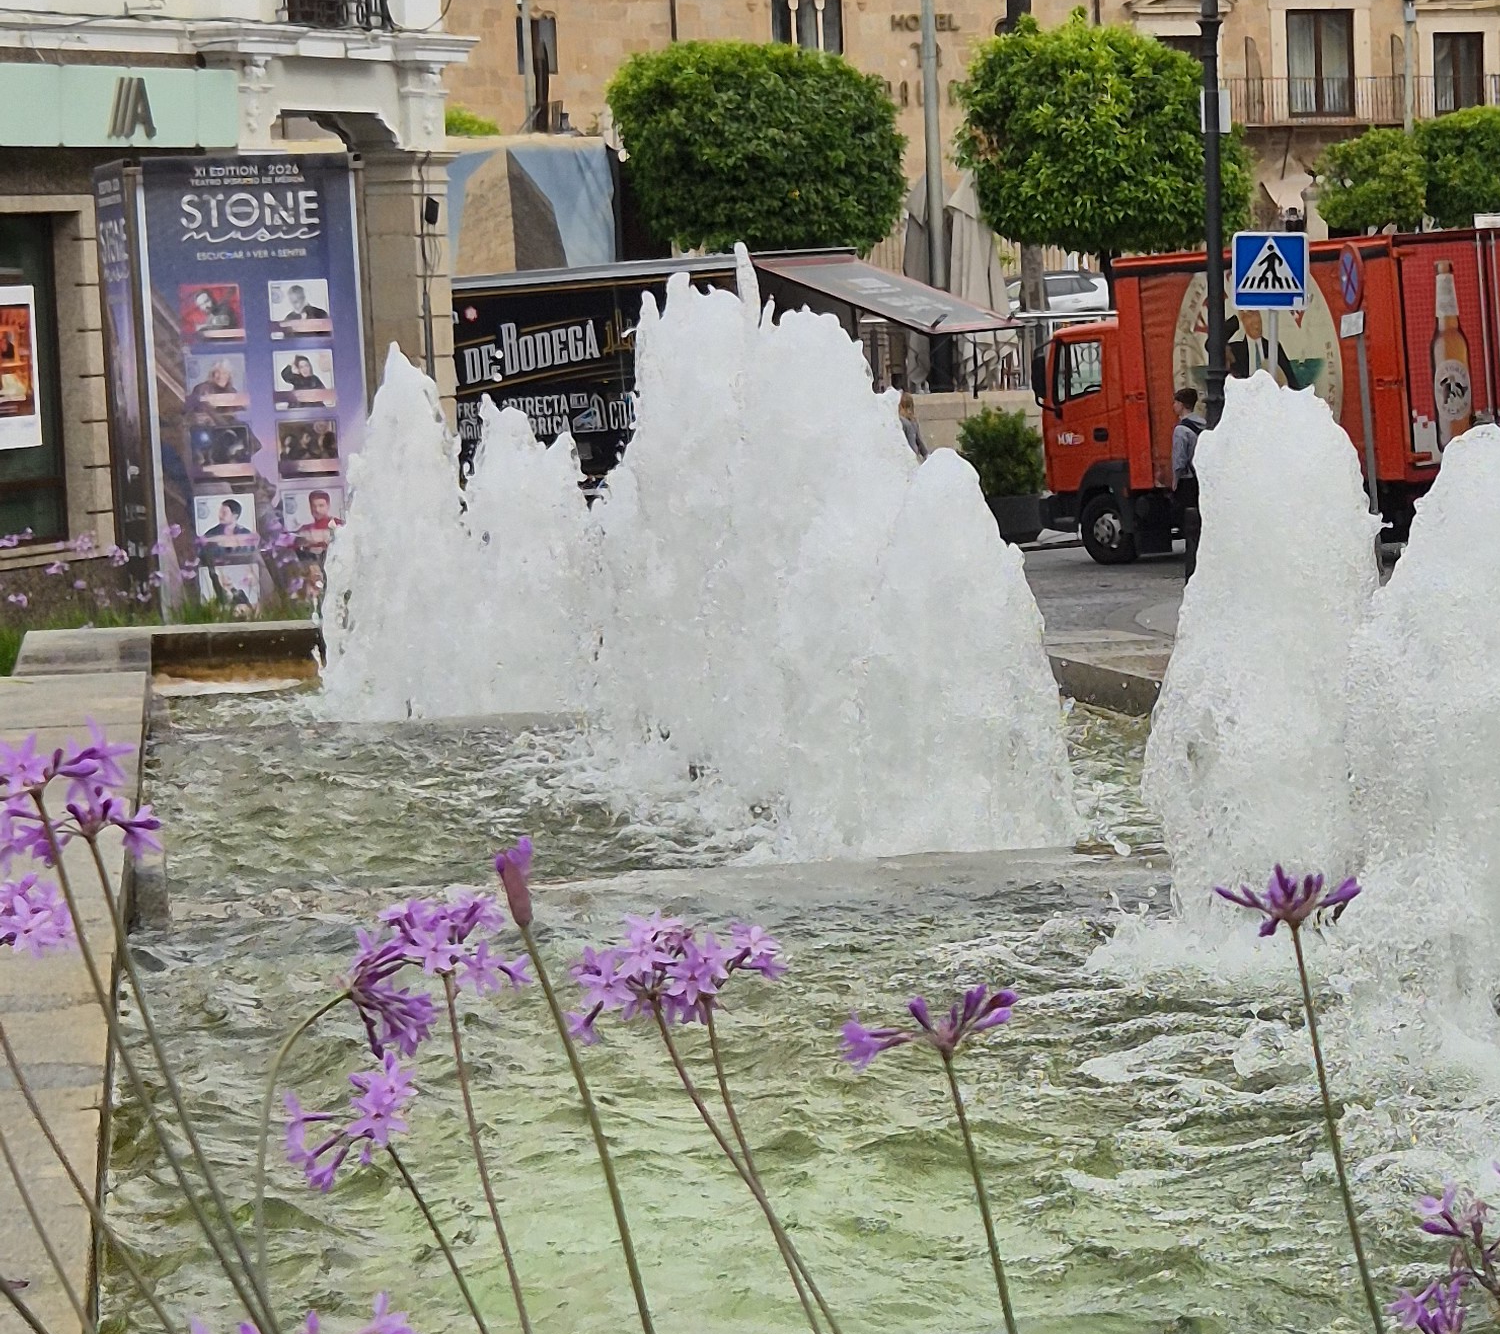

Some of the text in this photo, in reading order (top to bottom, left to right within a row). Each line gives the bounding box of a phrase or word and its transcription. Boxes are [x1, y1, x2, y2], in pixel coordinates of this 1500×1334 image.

[890, 13, 960, 32] HOEL
[194, 163, 299, 177] XI EDITION 2026
[181, 191, 320, 229] STONE
[463, 343, 500, 385] DE
[500, 319, 601, 376] BODEGA
